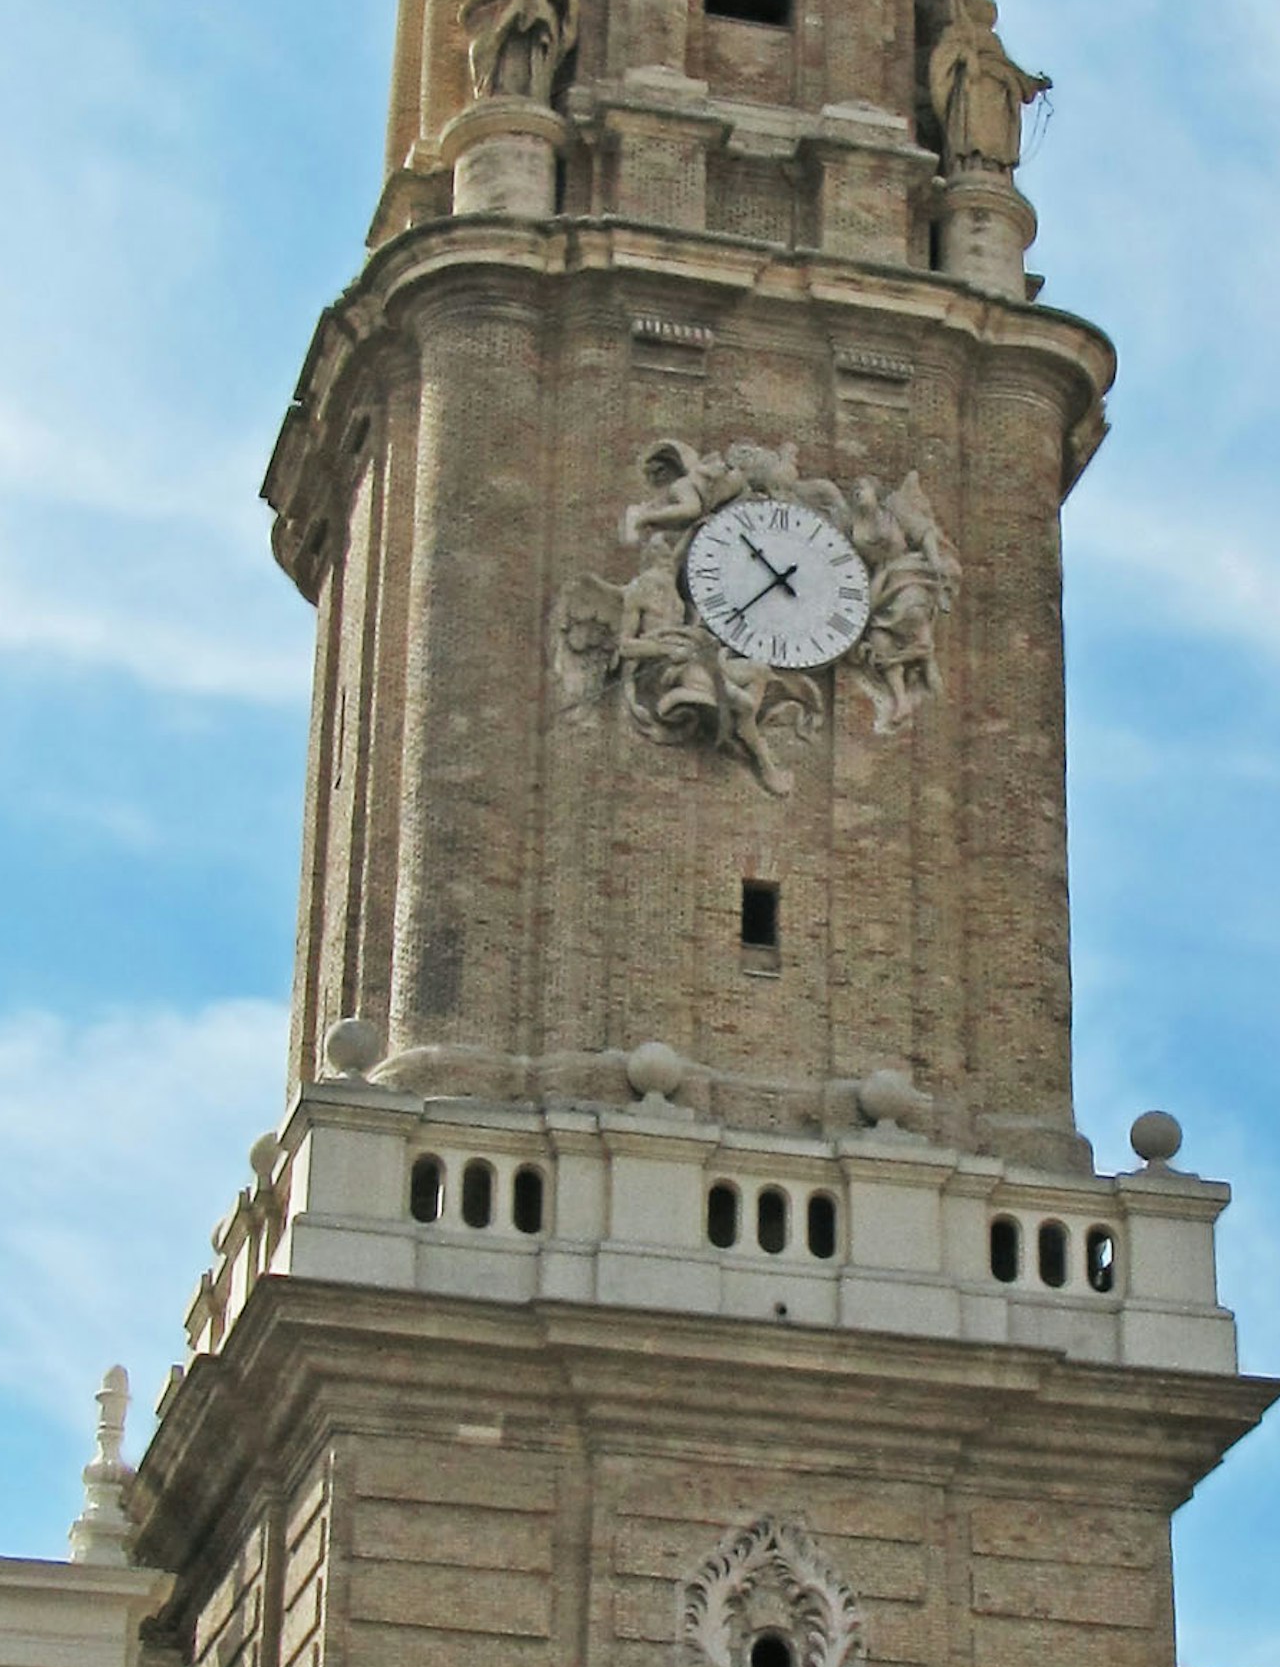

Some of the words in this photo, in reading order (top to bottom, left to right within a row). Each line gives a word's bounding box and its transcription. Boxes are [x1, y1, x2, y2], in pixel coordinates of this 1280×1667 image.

[770, 507, 789, 532] XII
[829, 552, 854, 568] II
[837, 585, 864, 602] III
